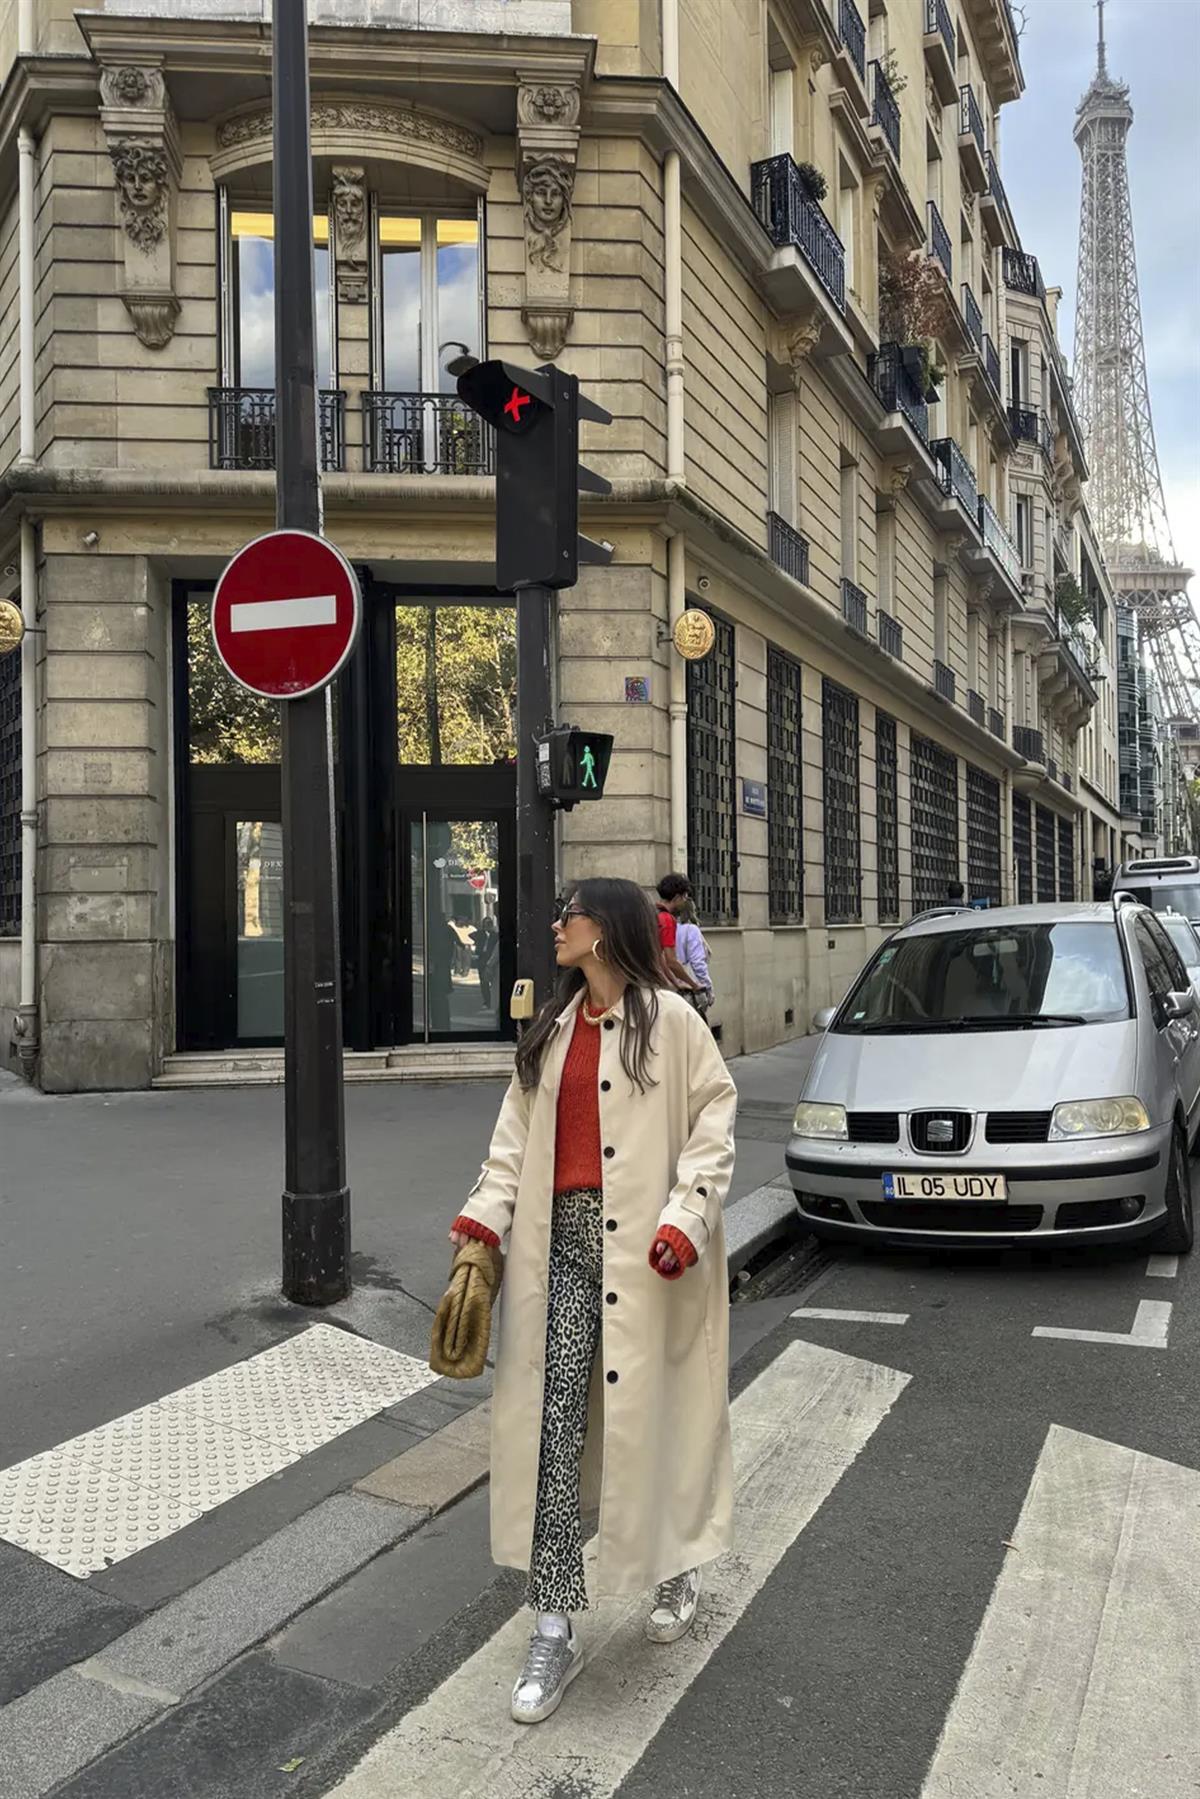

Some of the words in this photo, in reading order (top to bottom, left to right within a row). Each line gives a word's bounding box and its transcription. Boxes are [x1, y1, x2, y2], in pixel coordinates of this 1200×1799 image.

[897, 1177, 914, 1196] IL
[921, 1177, 945, 1197] 05
[953, 1177, 998, 1197] UDY
